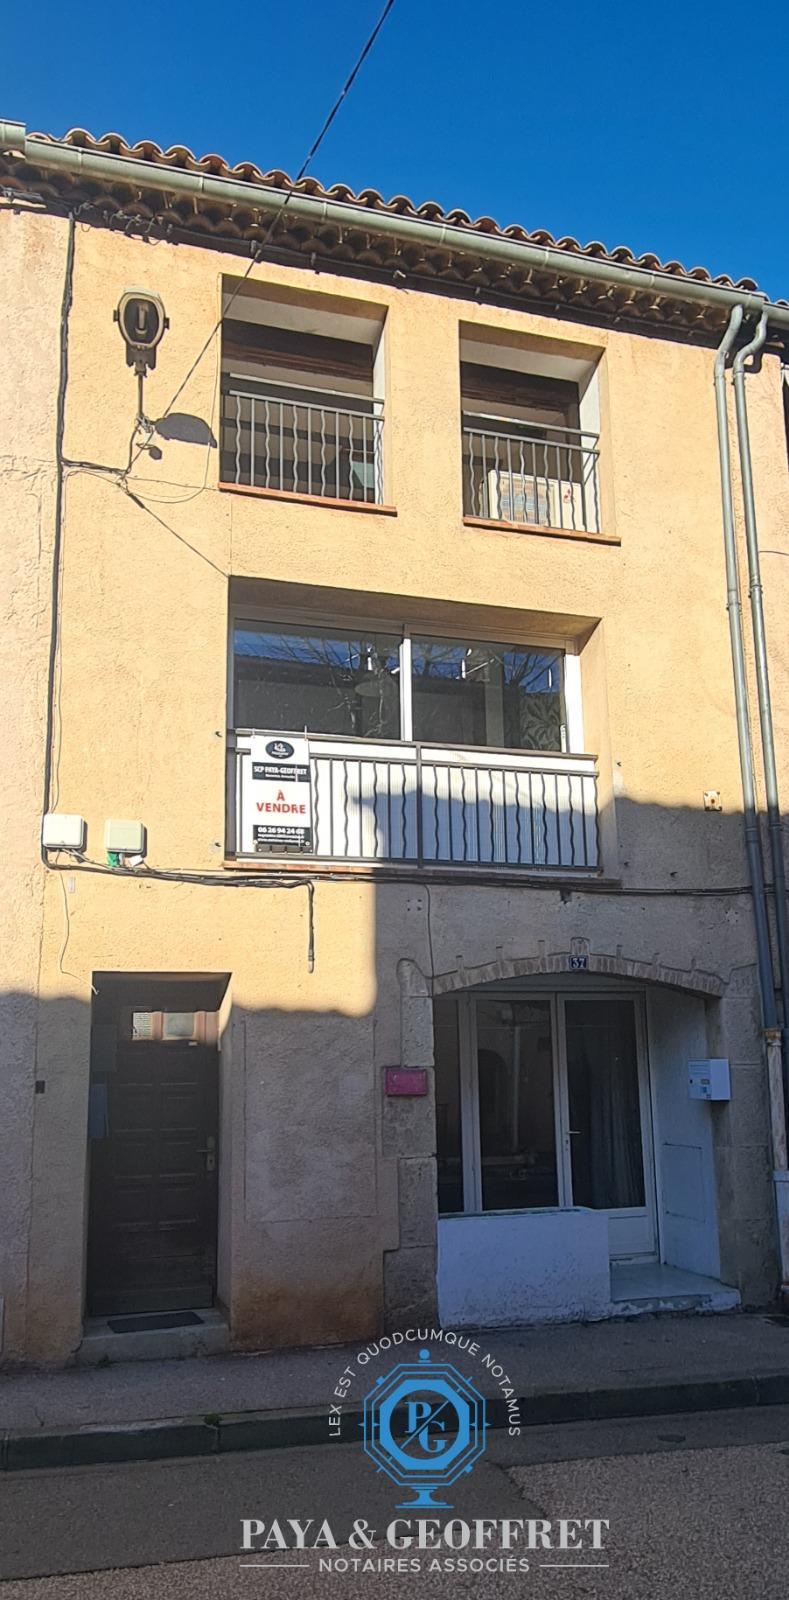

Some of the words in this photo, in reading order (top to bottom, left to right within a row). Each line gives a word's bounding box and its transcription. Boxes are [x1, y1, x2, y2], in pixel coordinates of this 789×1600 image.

[277, 789, 285, 801] À
[256, 802, 306, 814] VENDRE
[572, 957, 585, 968] 37
